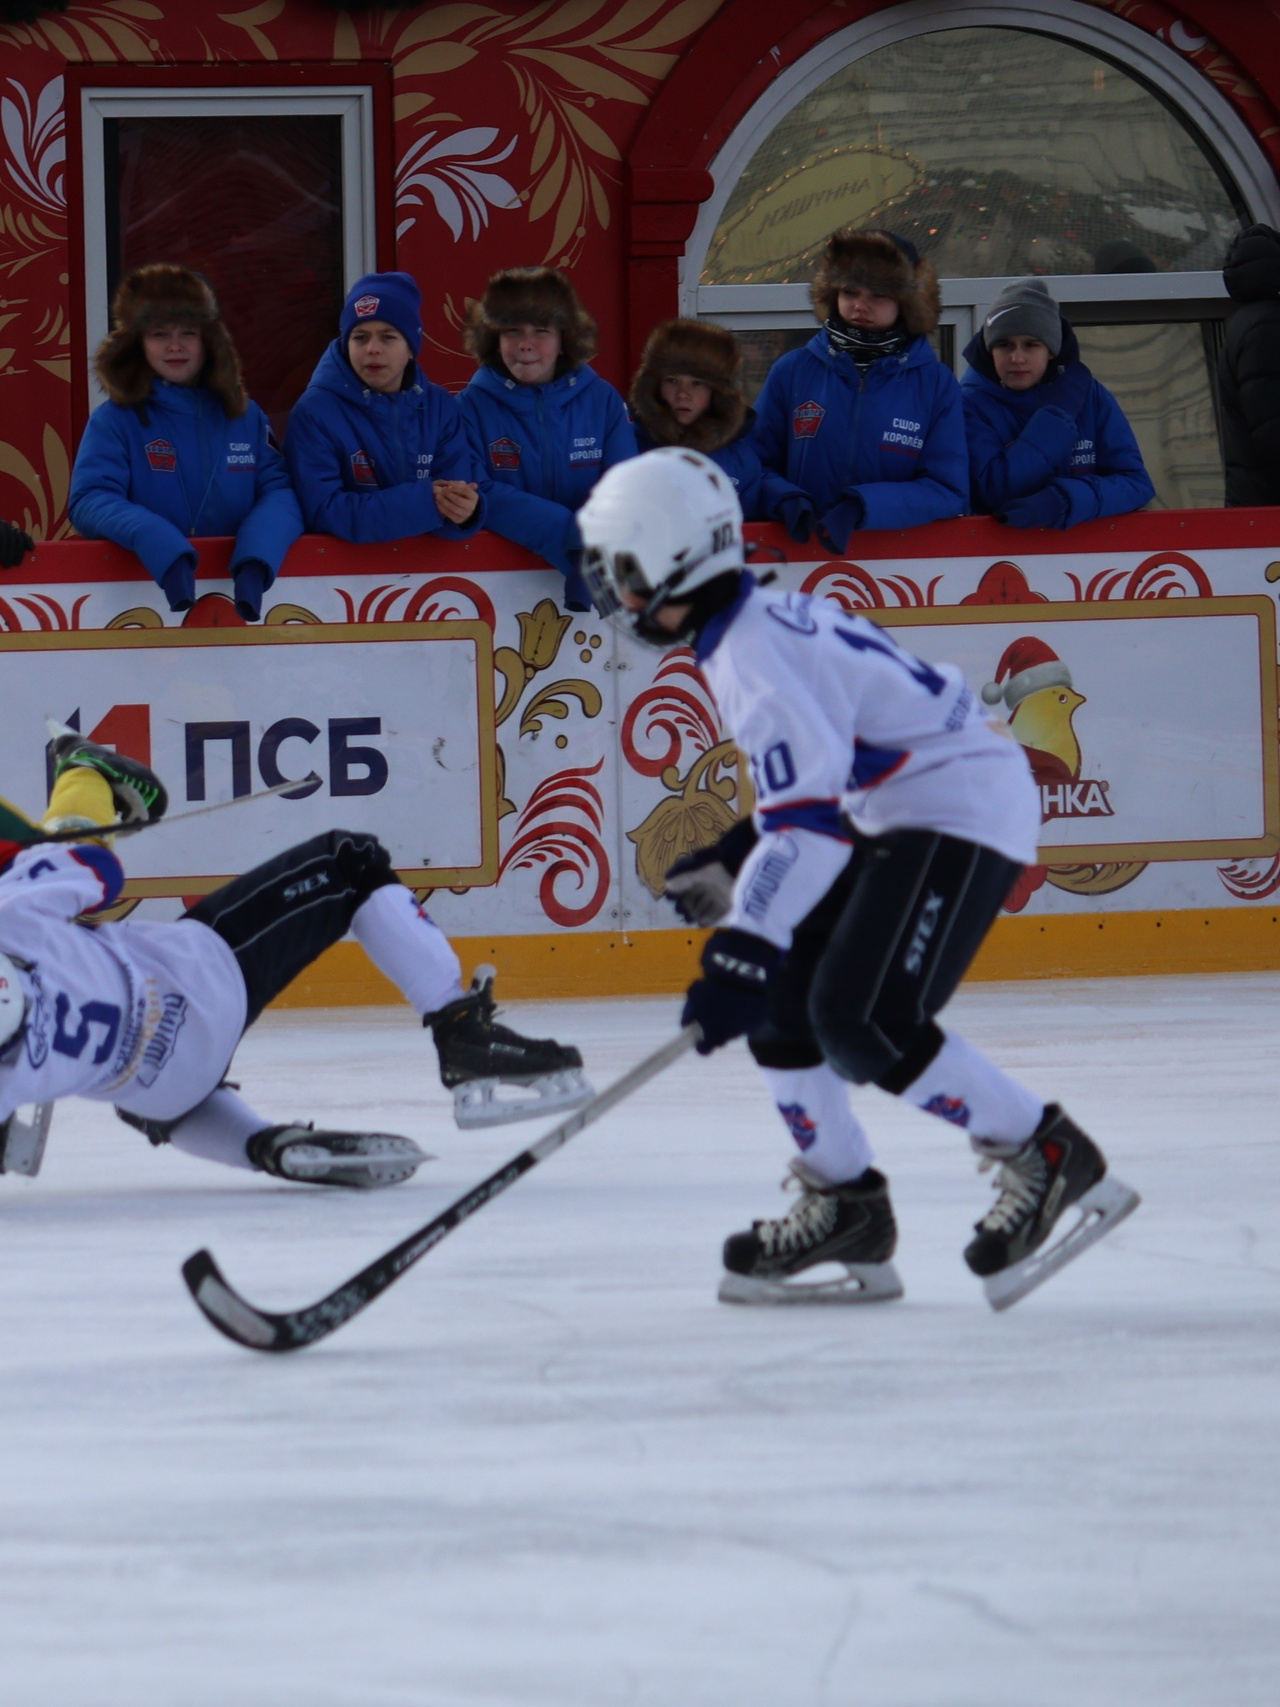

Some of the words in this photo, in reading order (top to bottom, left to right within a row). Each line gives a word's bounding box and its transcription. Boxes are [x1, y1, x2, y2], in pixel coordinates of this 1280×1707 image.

[892, 417, 921, 432] СШОР
[229, 442, 251, 452] СШОР
[573, 437, 597, 447] СШОР
[882, 430, 924, 449] КОРОЛЁВ
[226, 452, 256, 465] КОРОЛЁ
[184, 717, 389, 801] ПСБ
[1037, 783, 1110, 814] НКА
[282, 869, 330, 902] STEX
[52, 991, 122, 1066] 5
